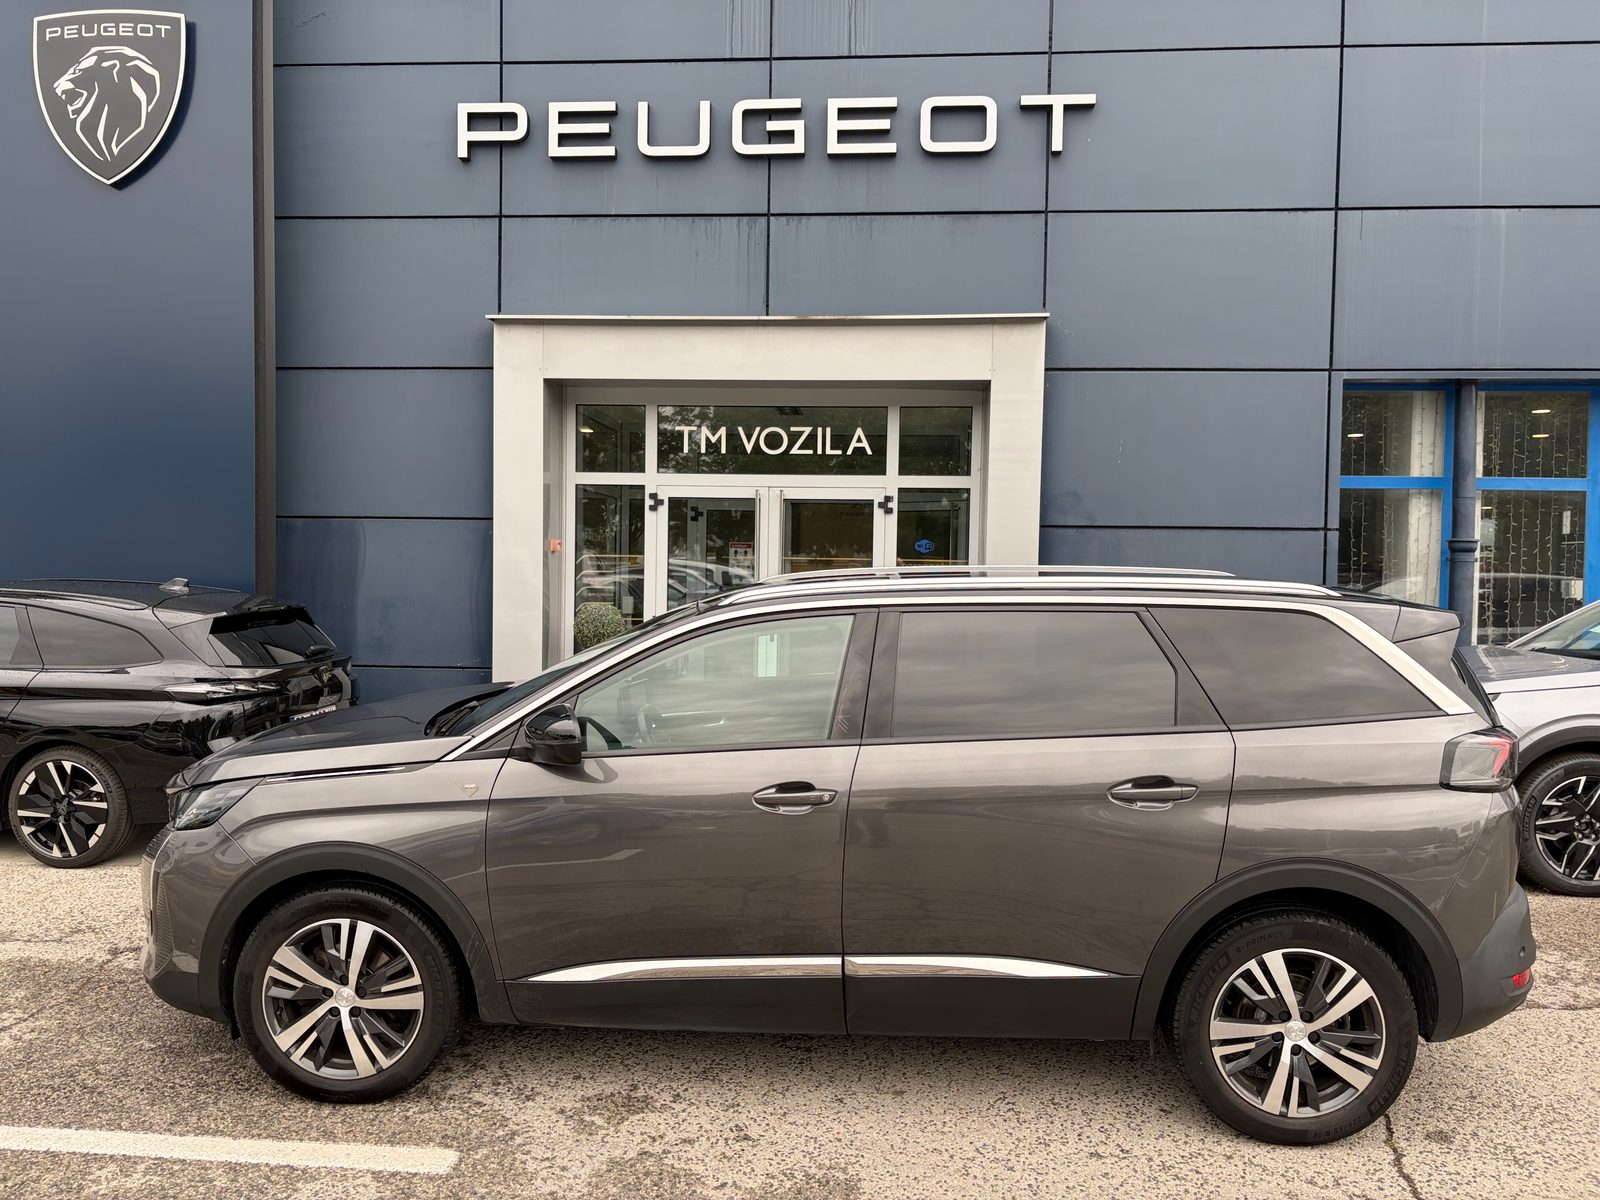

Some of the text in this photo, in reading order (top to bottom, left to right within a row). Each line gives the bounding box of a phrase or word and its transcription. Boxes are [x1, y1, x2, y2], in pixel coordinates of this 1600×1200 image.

[46, 23, 171, 41] PEUGEOT
[456, 93, 1097, 160] PEUGEOT
[675, 426, 873, 455] TM VOZILA
[1523, 797, 1536, 839] MICHELIN
[1187, 954, 1231, 1023] MICHELIN
